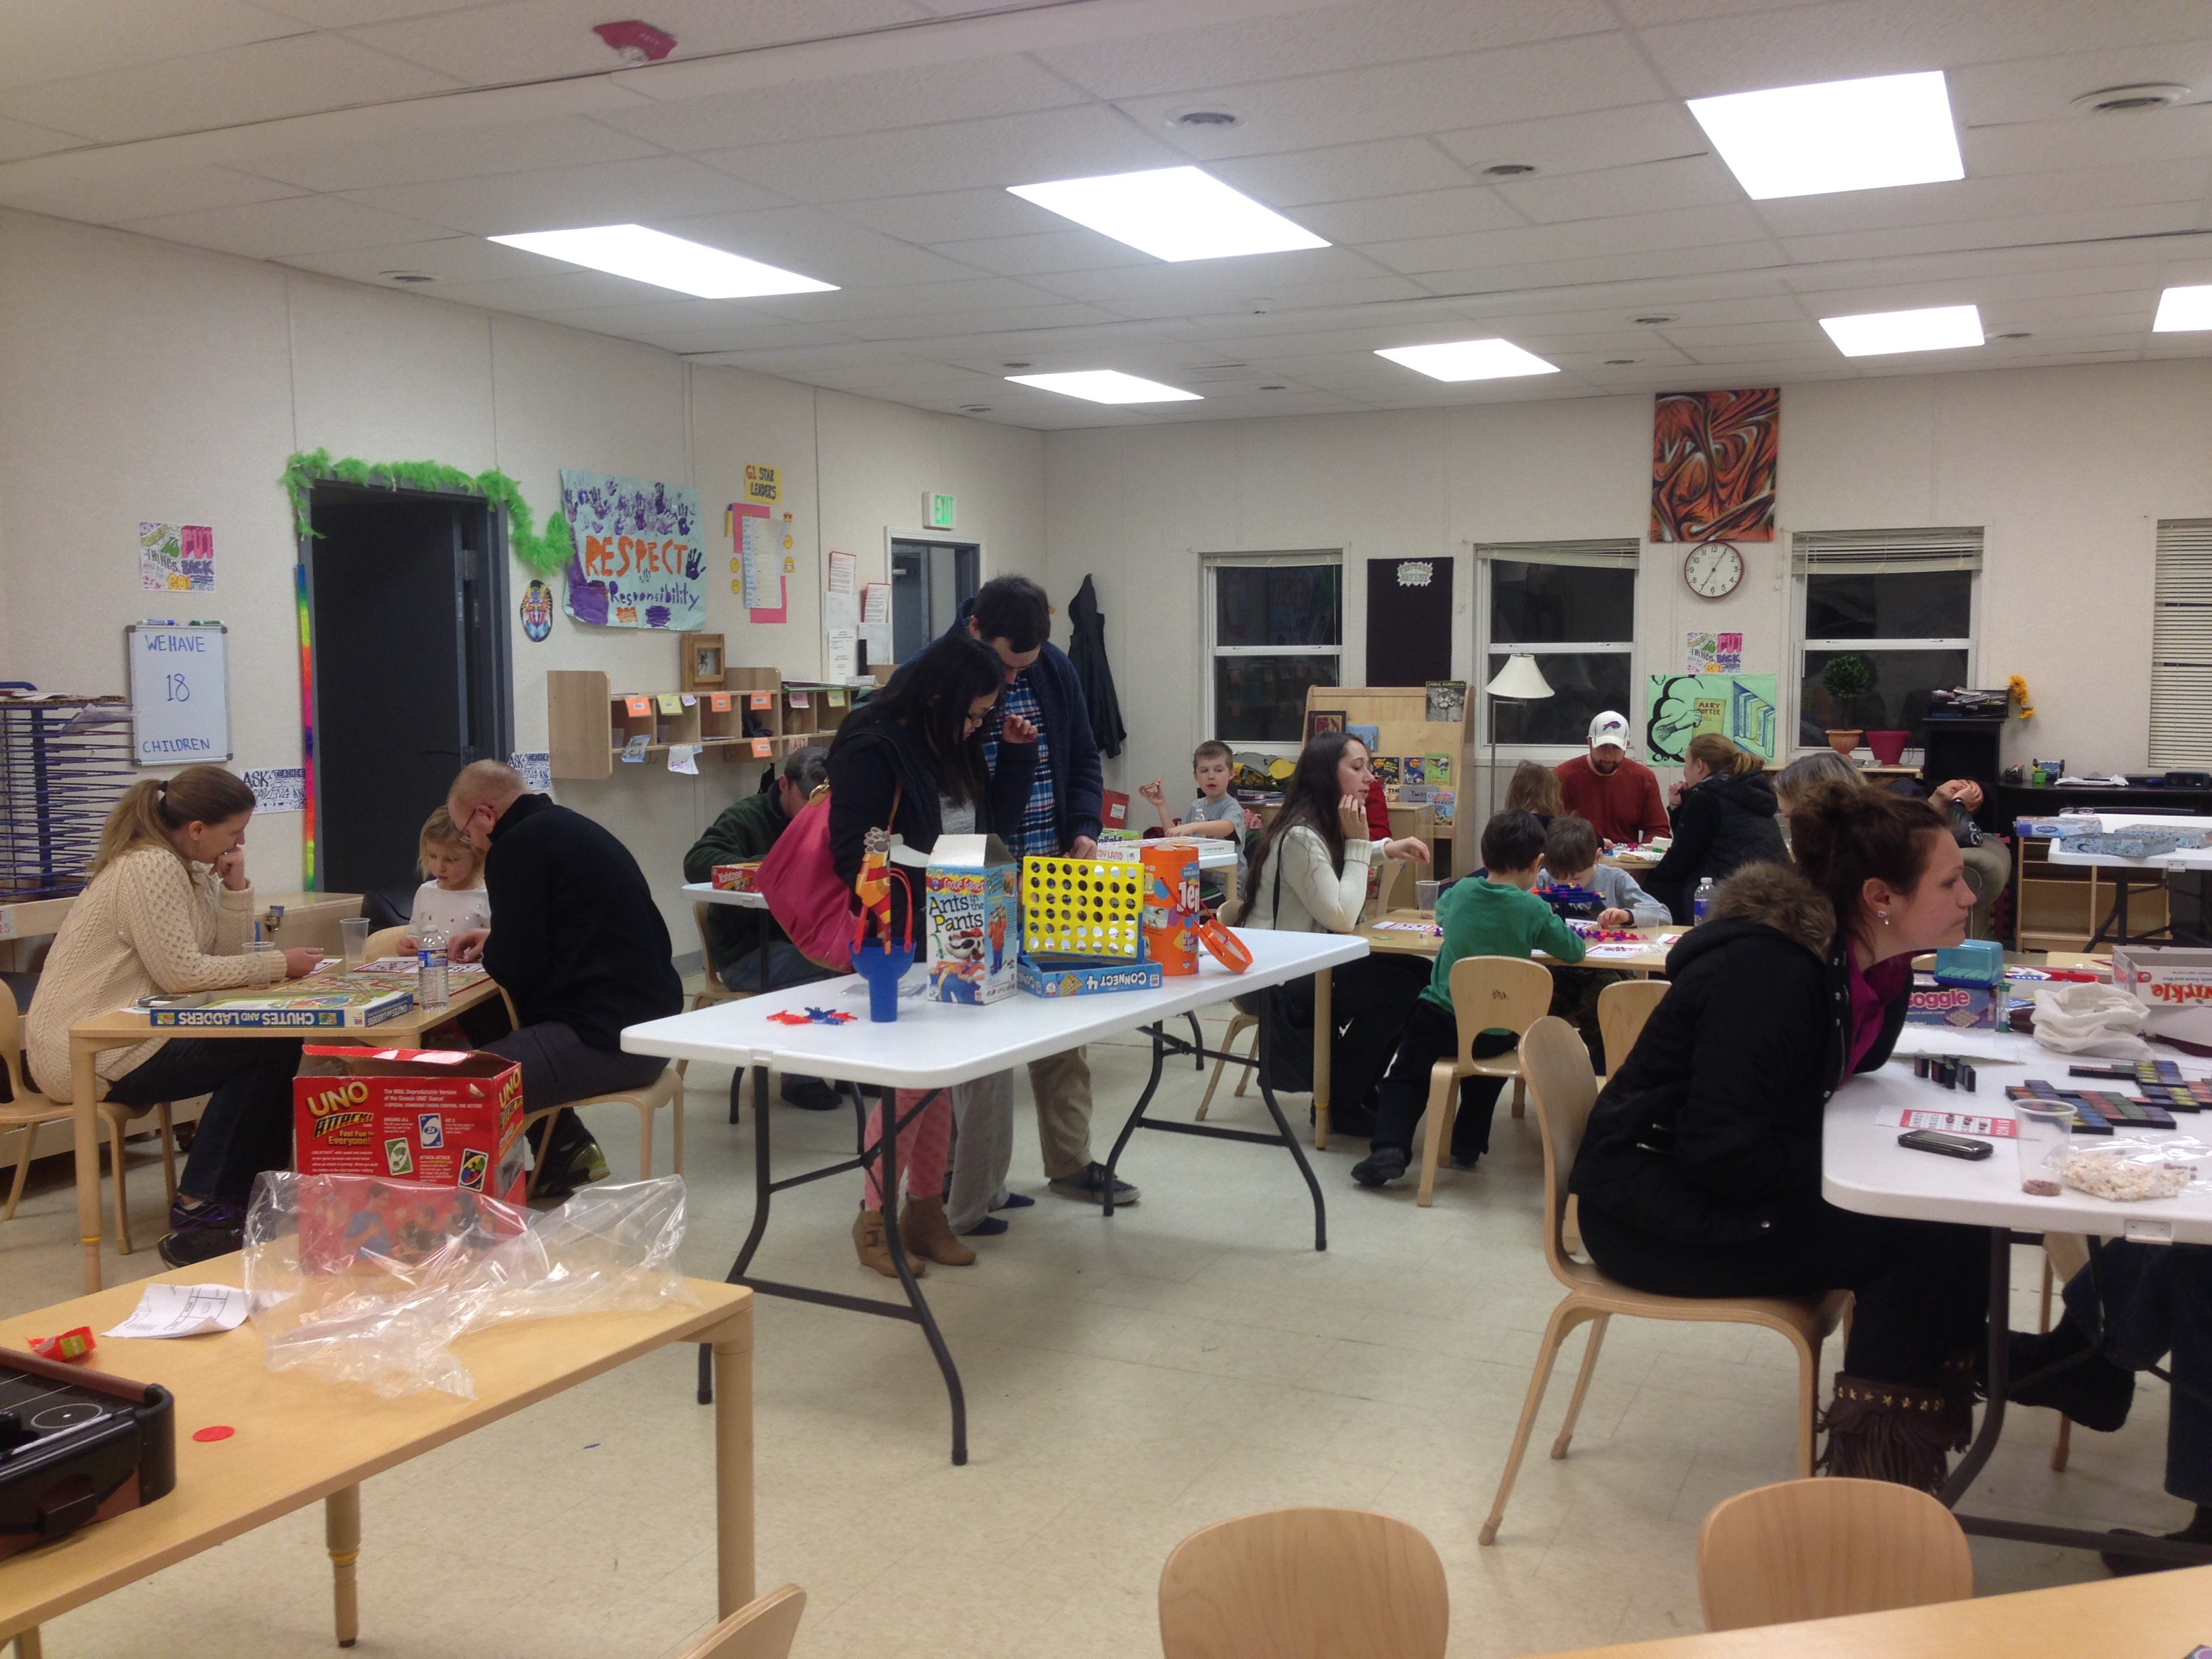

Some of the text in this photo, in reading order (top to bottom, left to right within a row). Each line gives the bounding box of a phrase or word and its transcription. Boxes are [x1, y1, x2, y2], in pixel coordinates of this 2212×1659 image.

[758, 467, 775, 482] STAR
[750, 482, 777, 500] LEADERS
[935, 495, 954, 525] EXIT
[181, 525, 214, 559] PUT
[144, 548, 178, 572] THINGS
[585, 535, 689, 577] RESPECT
[609, 580, 700, 612] Responsibility
[1717, 632, 1743, 654] PUT
[167, 673, 190, 702] 18
[142, 739, 211, 754] CHILDREN
[244, 771, 269, 788] ASK
[928, 895, 979, 916] Ants in
[970, 902, 984, 911] the
[932, 912, 984, 933] Pants
[1086, 970, 1147, 990] CONNECT 4
[178, 1012, 314, 1026] CHUTES AND LADDERS
[306, 1081, 369, 1117] UNO
[499, 1068, 521, 1109] UNO
[328, 1136, 371, 1147] Everyone!
